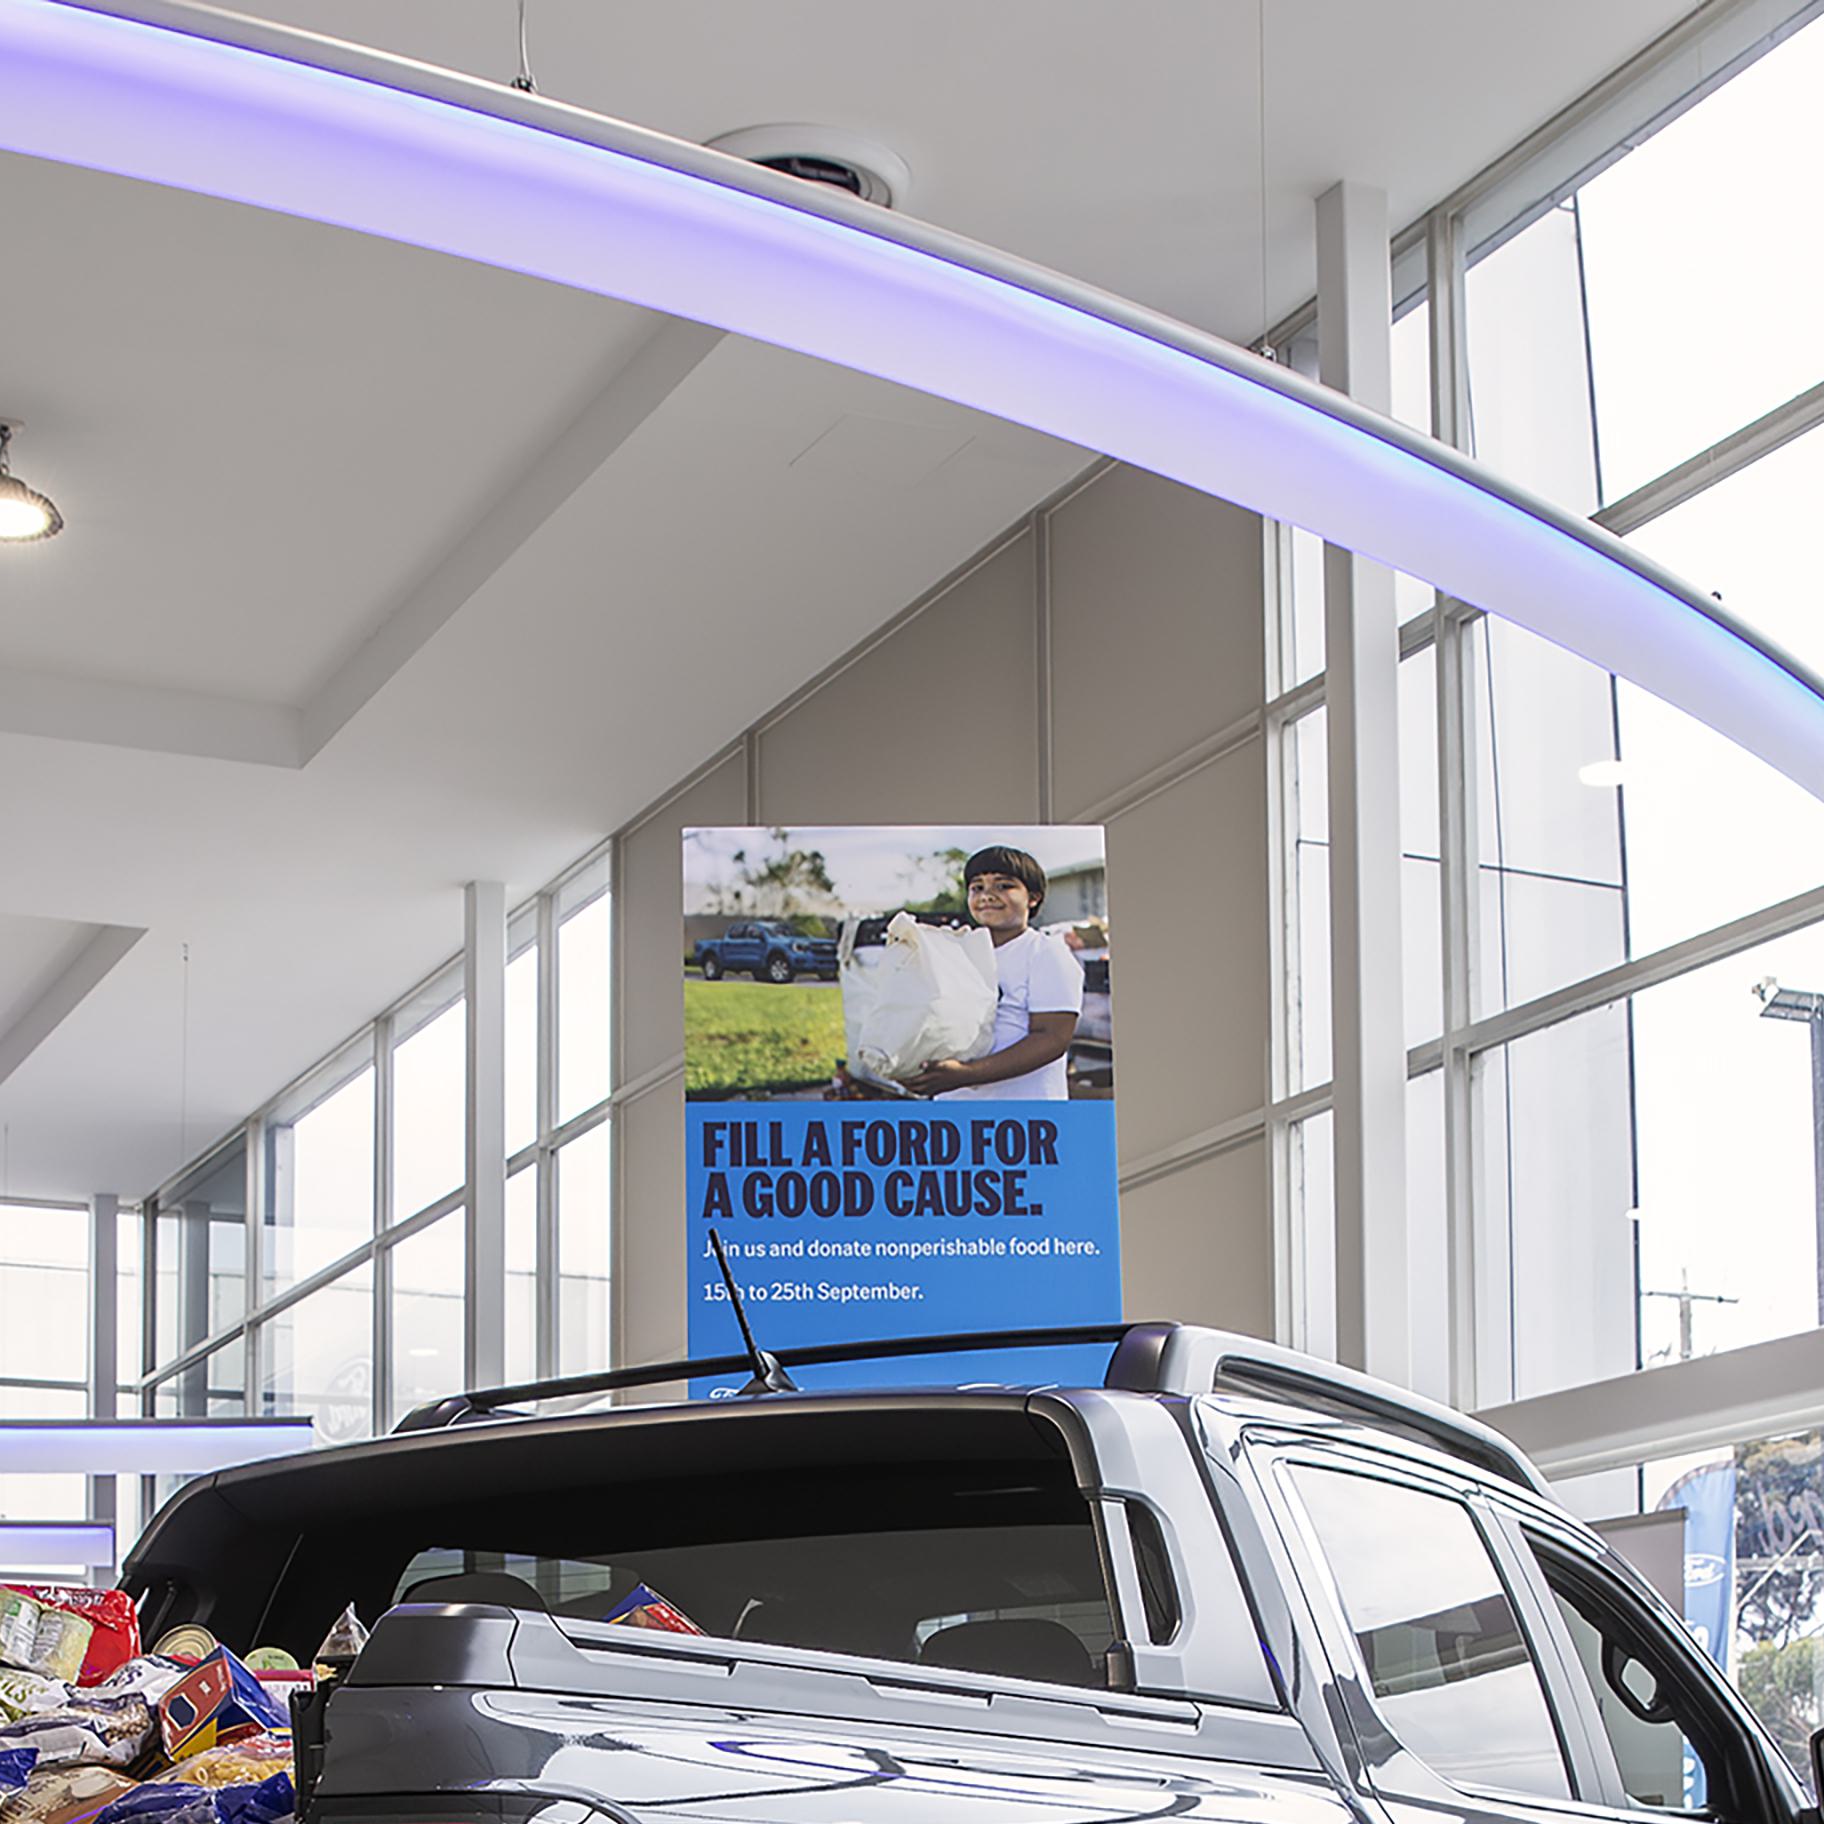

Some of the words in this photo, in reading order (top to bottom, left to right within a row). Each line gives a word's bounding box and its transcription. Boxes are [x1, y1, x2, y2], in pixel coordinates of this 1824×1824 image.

[703, 1121, 792, 1168] FILL
[801, 1120, 833, 1166] A
[841, 1119, 961, 1166] FORD
[971, 1119, 1058, 1165] FOR
[703, 1171, 733, 1218] A
[742, 1170, 873, 1217] GOOD
[884, 1169, 1043, 1216] CAUSE.
[703, 1240, 741, 1258] Jin
[744, 1242, 766, 1258] us
[770, 1239, 804, 1258] and
[809, 1238, 872, 1257] donate
[876, 1237, 1006, 1261] nonperishable
[1009, 1237, 1051, 1256] food
[1055, 1238, 1102, 1256] here.
[749, 1285, 768, 1301] to
[771, 1282, 814, 1301] 25th
[817, 1283, 924, 1304] September.
